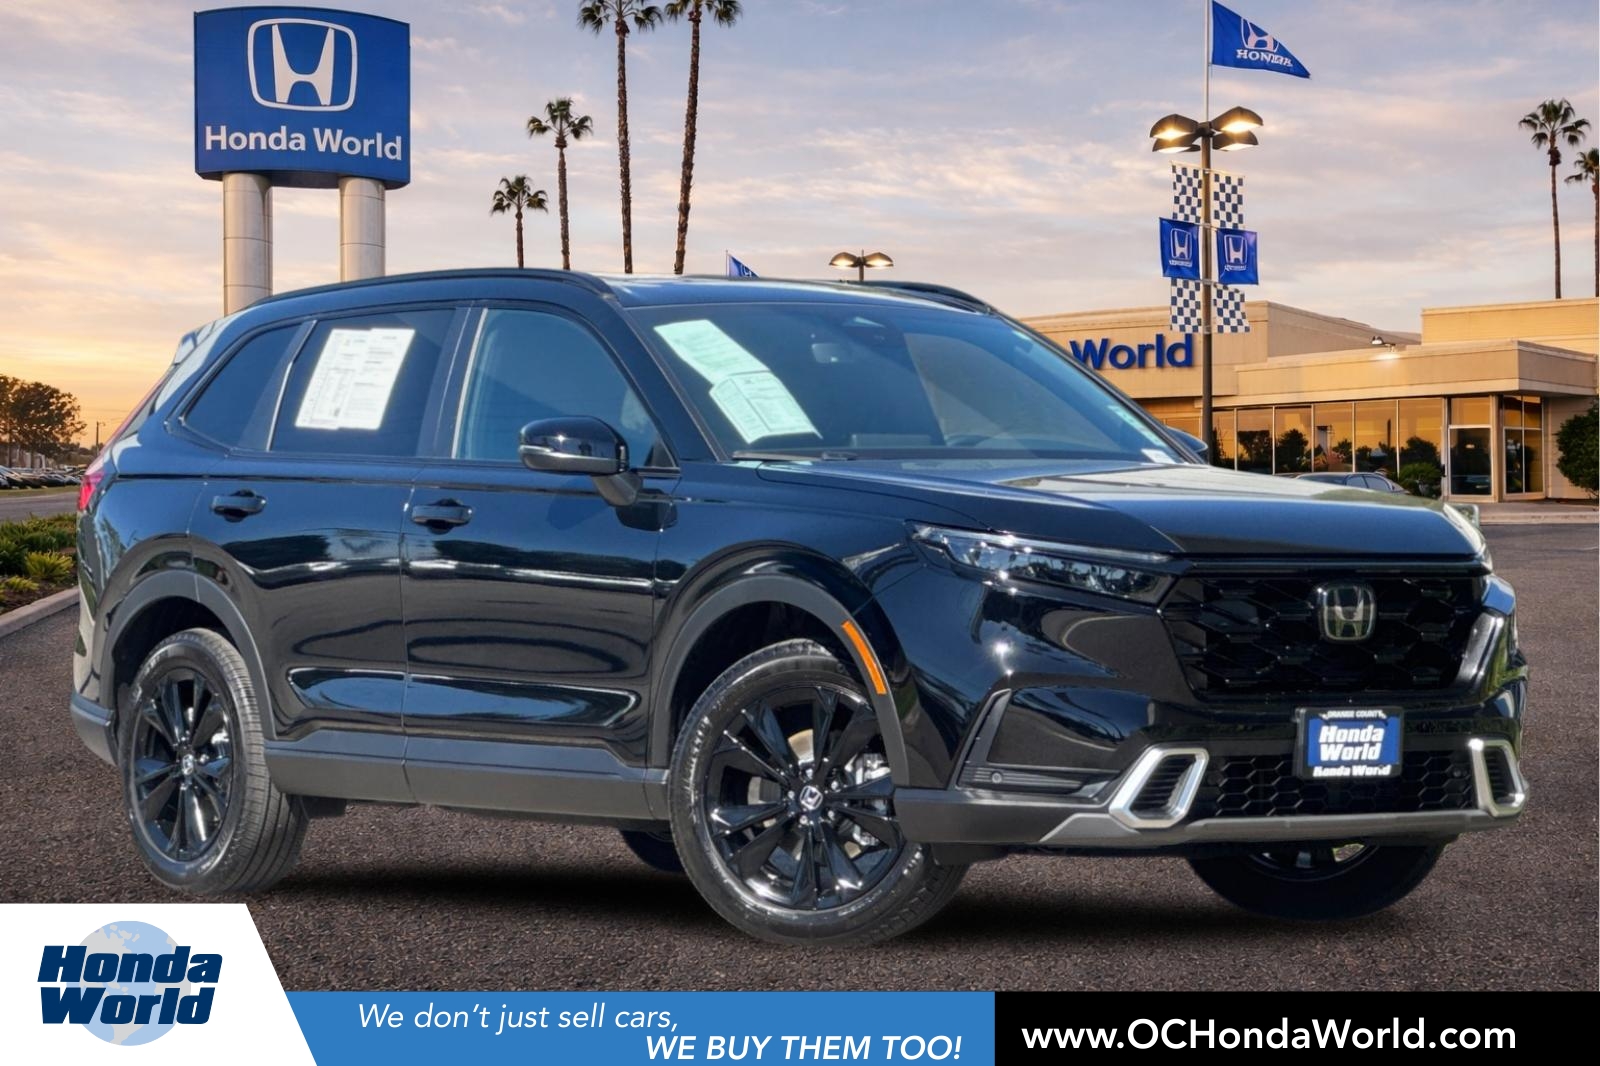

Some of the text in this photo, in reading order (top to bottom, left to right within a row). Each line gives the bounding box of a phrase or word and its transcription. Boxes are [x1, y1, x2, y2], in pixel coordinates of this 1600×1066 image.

[205, 125, 402, 161] Honda World
[1069, 333, 1194, 370] World
[1319, 725, 1385, 743] Honda
[1320, 743, 1381, 761] World
